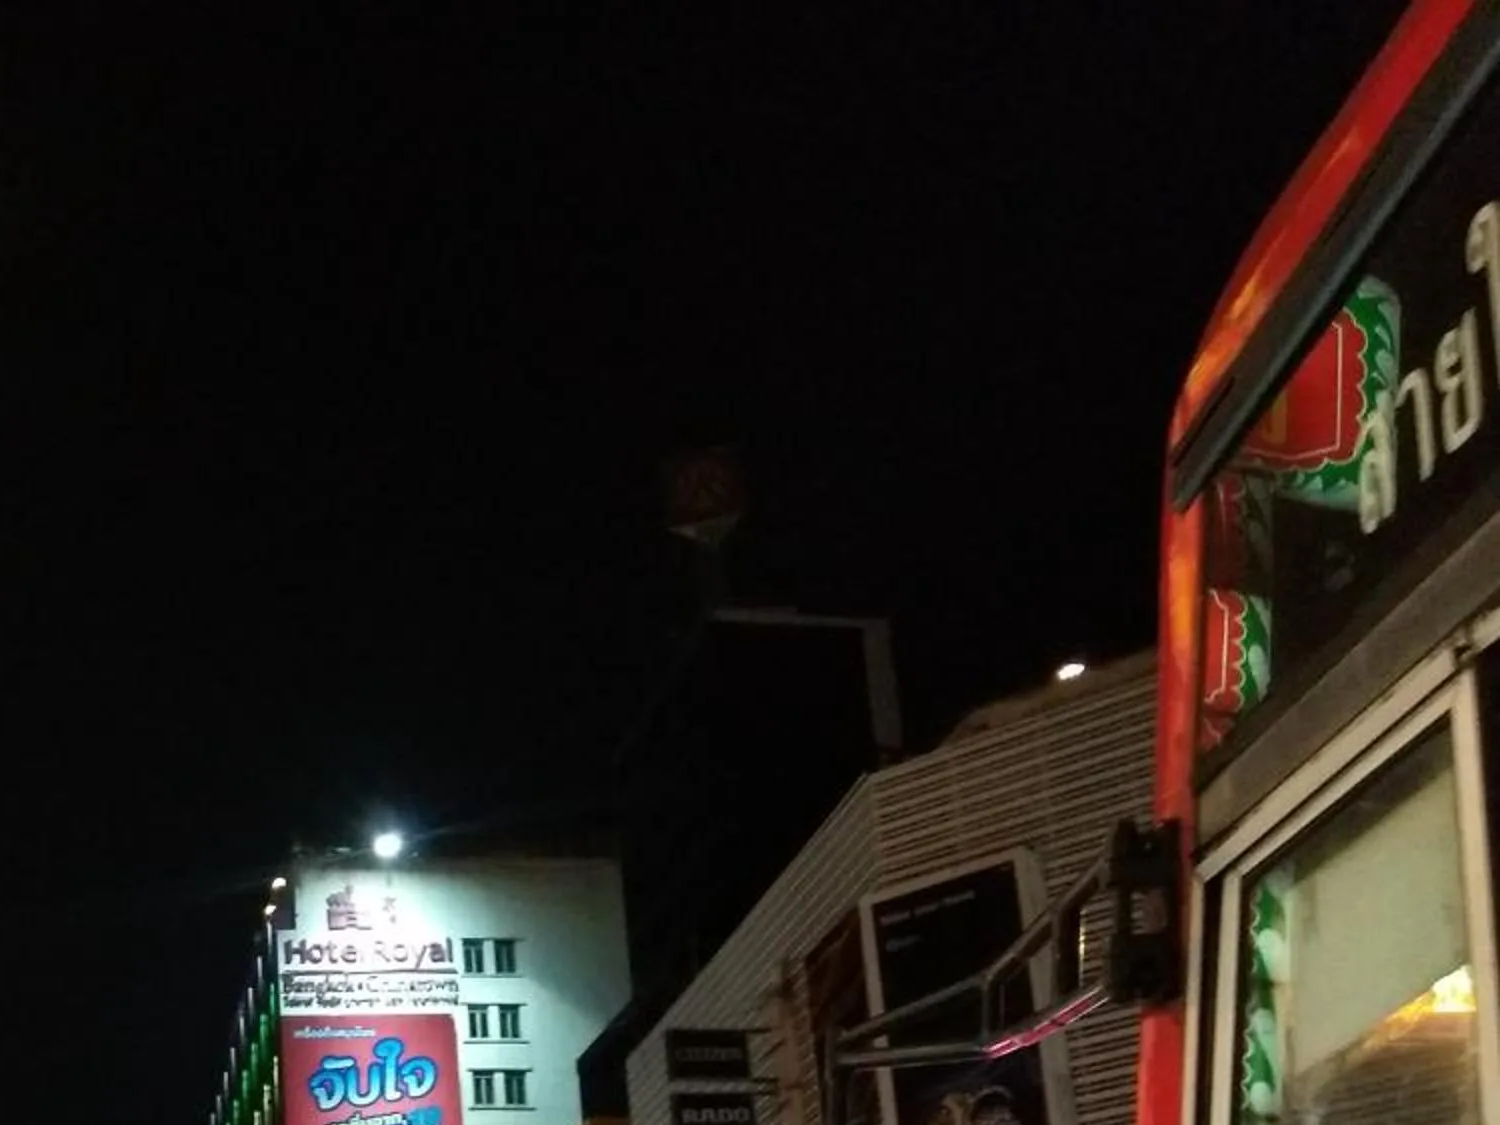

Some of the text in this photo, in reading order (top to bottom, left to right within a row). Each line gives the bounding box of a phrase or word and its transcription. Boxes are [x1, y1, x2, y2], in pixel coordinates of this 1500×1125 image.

[374, 937, 454, 969] Royal
[308, 1037, 438, 1112] จับใจ
[681, 1106, 751, 1124] RADO
